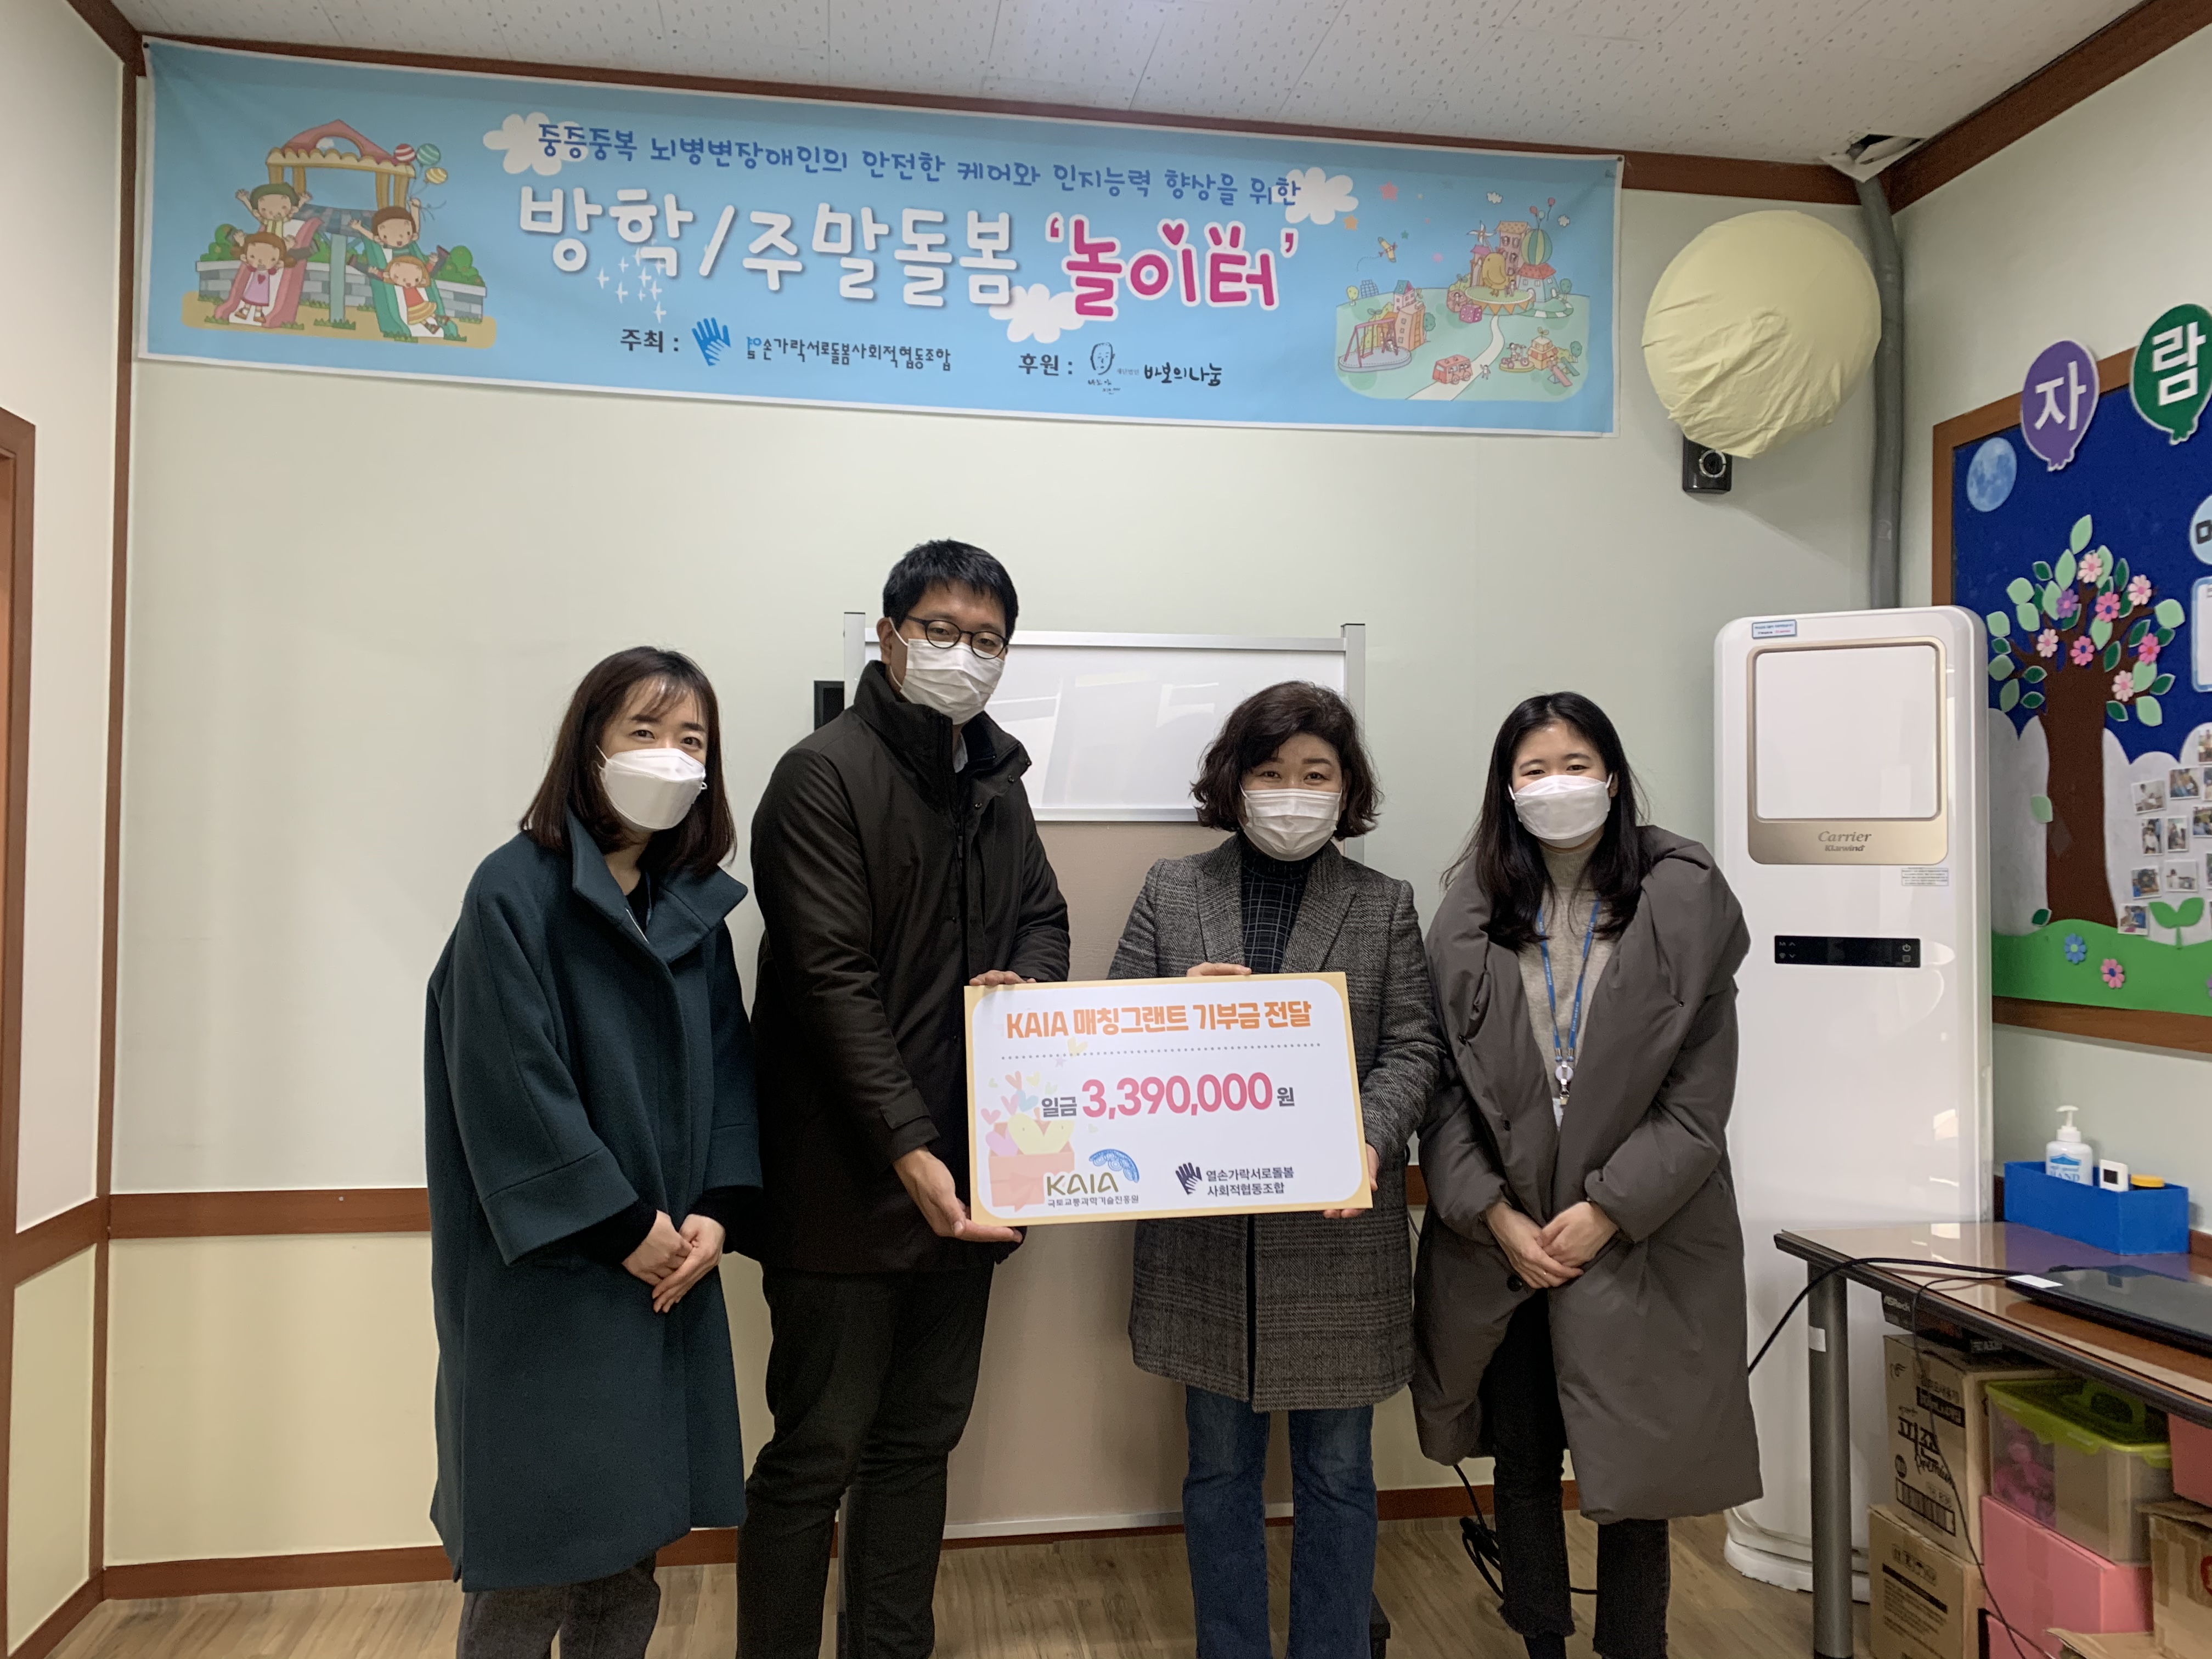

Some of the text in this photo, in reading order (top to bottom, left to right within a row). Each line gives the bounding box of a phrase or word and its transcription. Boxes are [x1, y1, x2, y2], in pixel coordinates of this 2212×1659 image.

[539, 123, 1301, 206] 중증중복 뇌병변장애인의 안전한 케어와 인지능력 향상을 위한
[1144, 362, 1222, 386] 바보의나눔
[1818, 831, 1872, 842] Carrier
[1007, 1001, 1312, 1039] KAIA 매칭그랜트 기부금 전달
[1047, 1172, 1119, 1197] KAIA
[1206, 1166, 1294, 1182] 열손가락서로돌봄
[1207, 1182, 1285, 1197] 사회적협동조합
